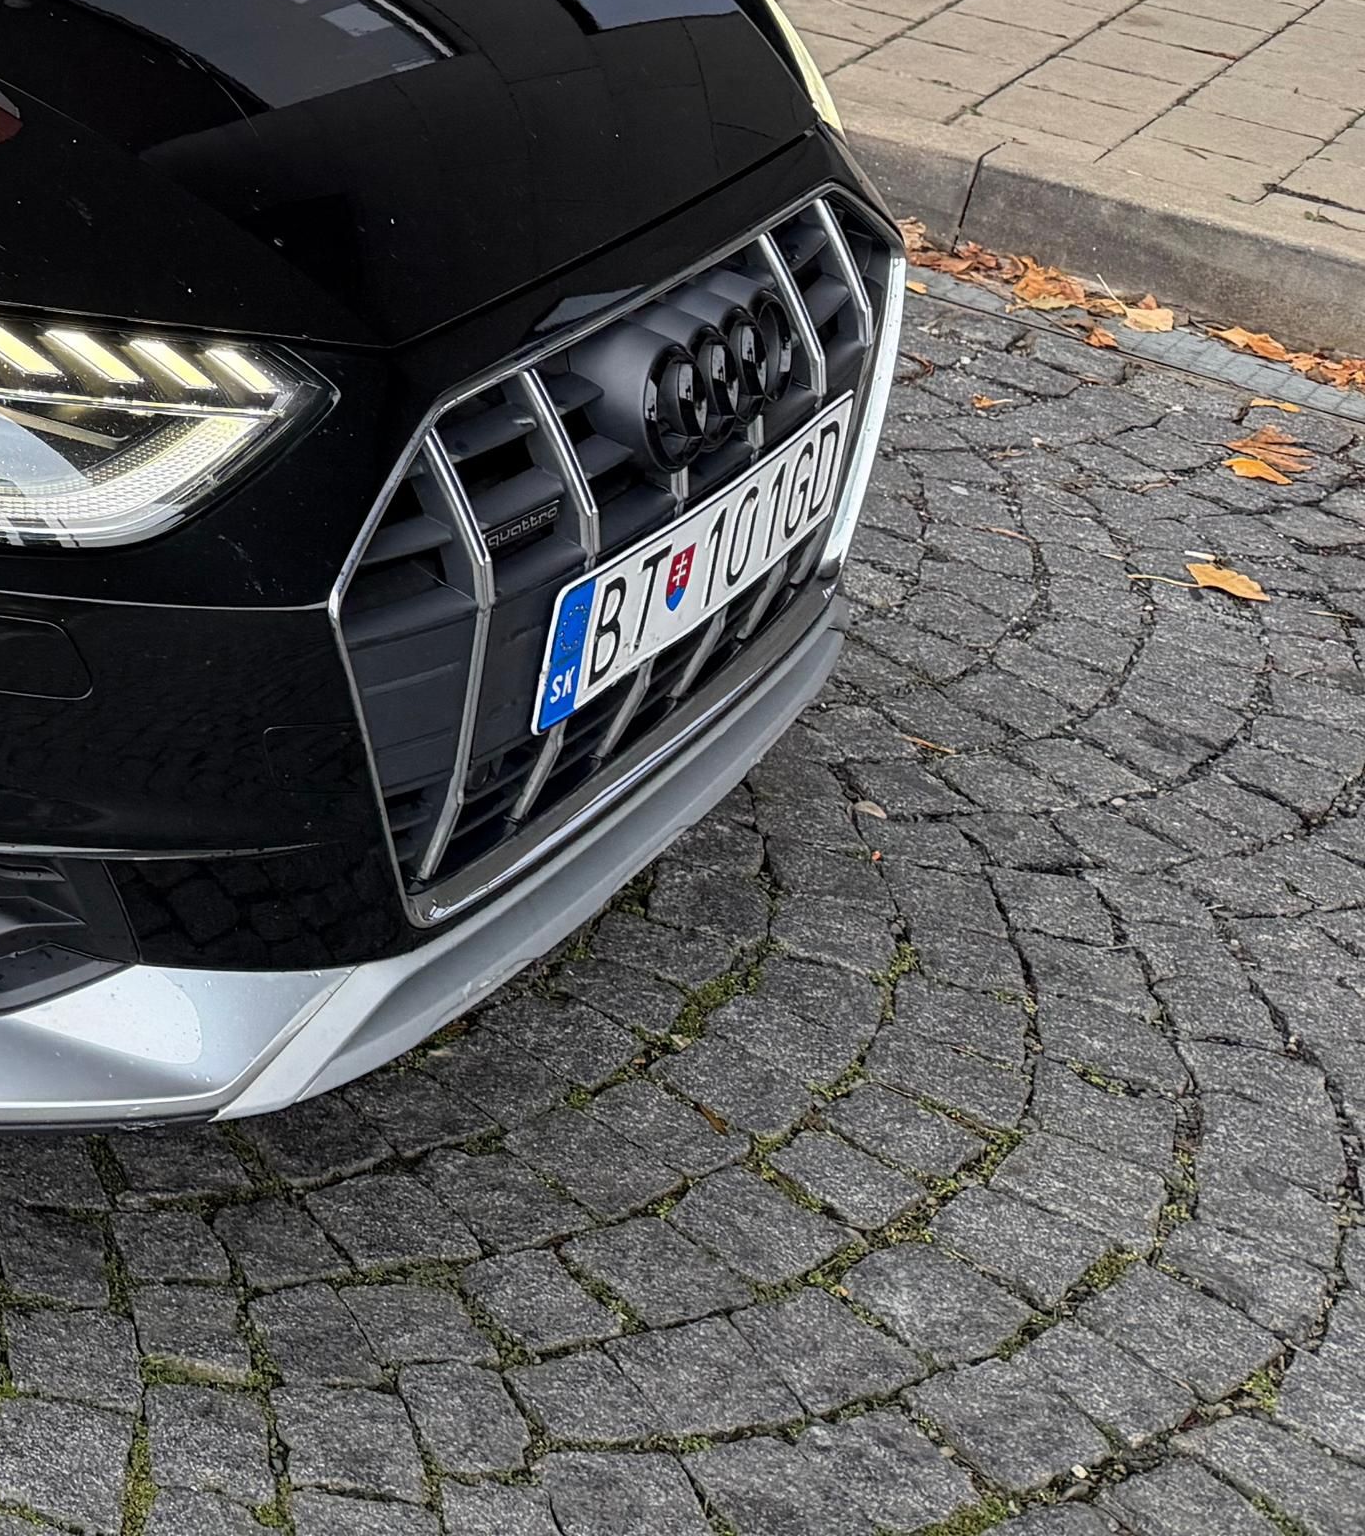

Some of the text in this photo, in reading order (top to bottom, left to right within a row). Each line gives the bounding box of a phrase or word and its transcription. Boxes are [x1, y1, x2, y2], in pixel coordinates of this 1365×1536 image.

[487, 506, 558, 547] quattro
[587, 419, 841, 690] BT 101GD
[549, 667, 573, 705] SK
